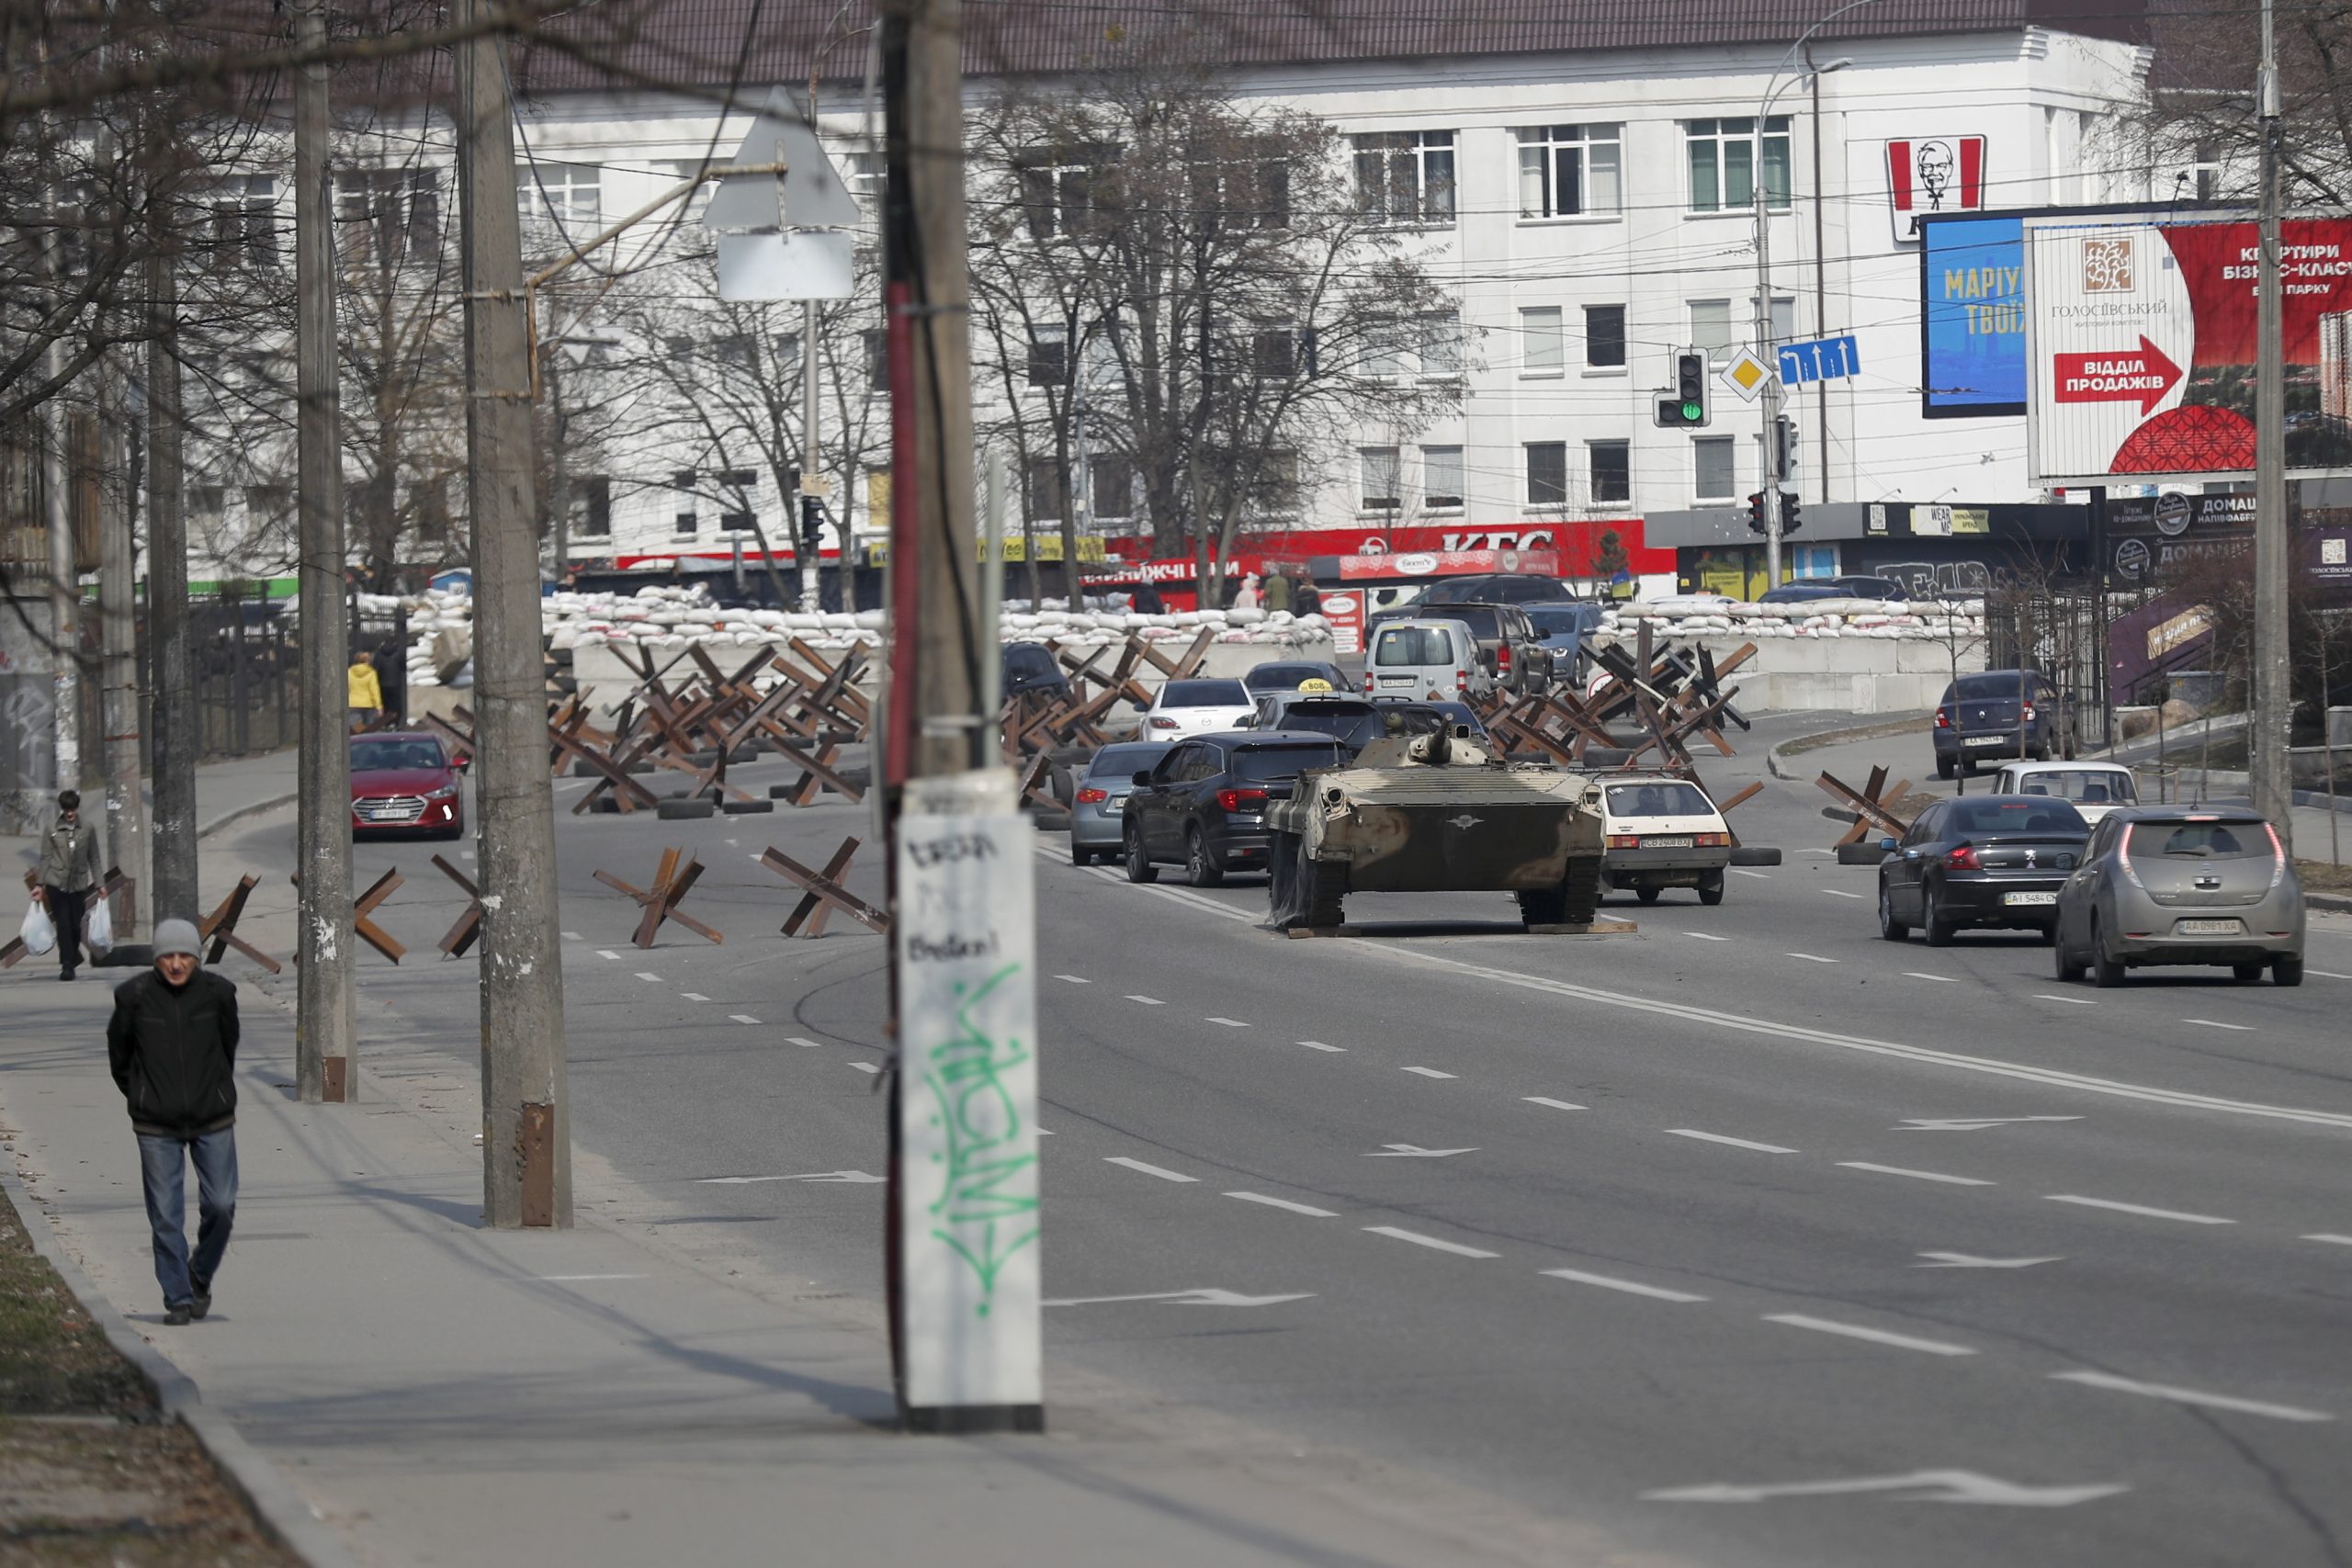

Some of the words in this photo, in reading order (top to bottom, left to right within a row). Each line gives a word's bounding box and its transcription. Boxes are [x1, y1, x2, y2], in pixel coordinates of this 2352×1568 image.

[1944, 265, 2024, 299] МАРІУ
[2286, 283, 2331, 295] ПАРКУ
[2052, 299, 2167, 318] ГОЛОСІЇВСЬКИЙ
[2084, 359, 2145, 376] ВІДДІЛ
[2066, 376, 2165, 392] ПРОДАЖІВ
[1930, 507, 1951, 521] WEAR
[1940, 521, 1951, 536] ME
[2186, 921, 2199, 931] AA
